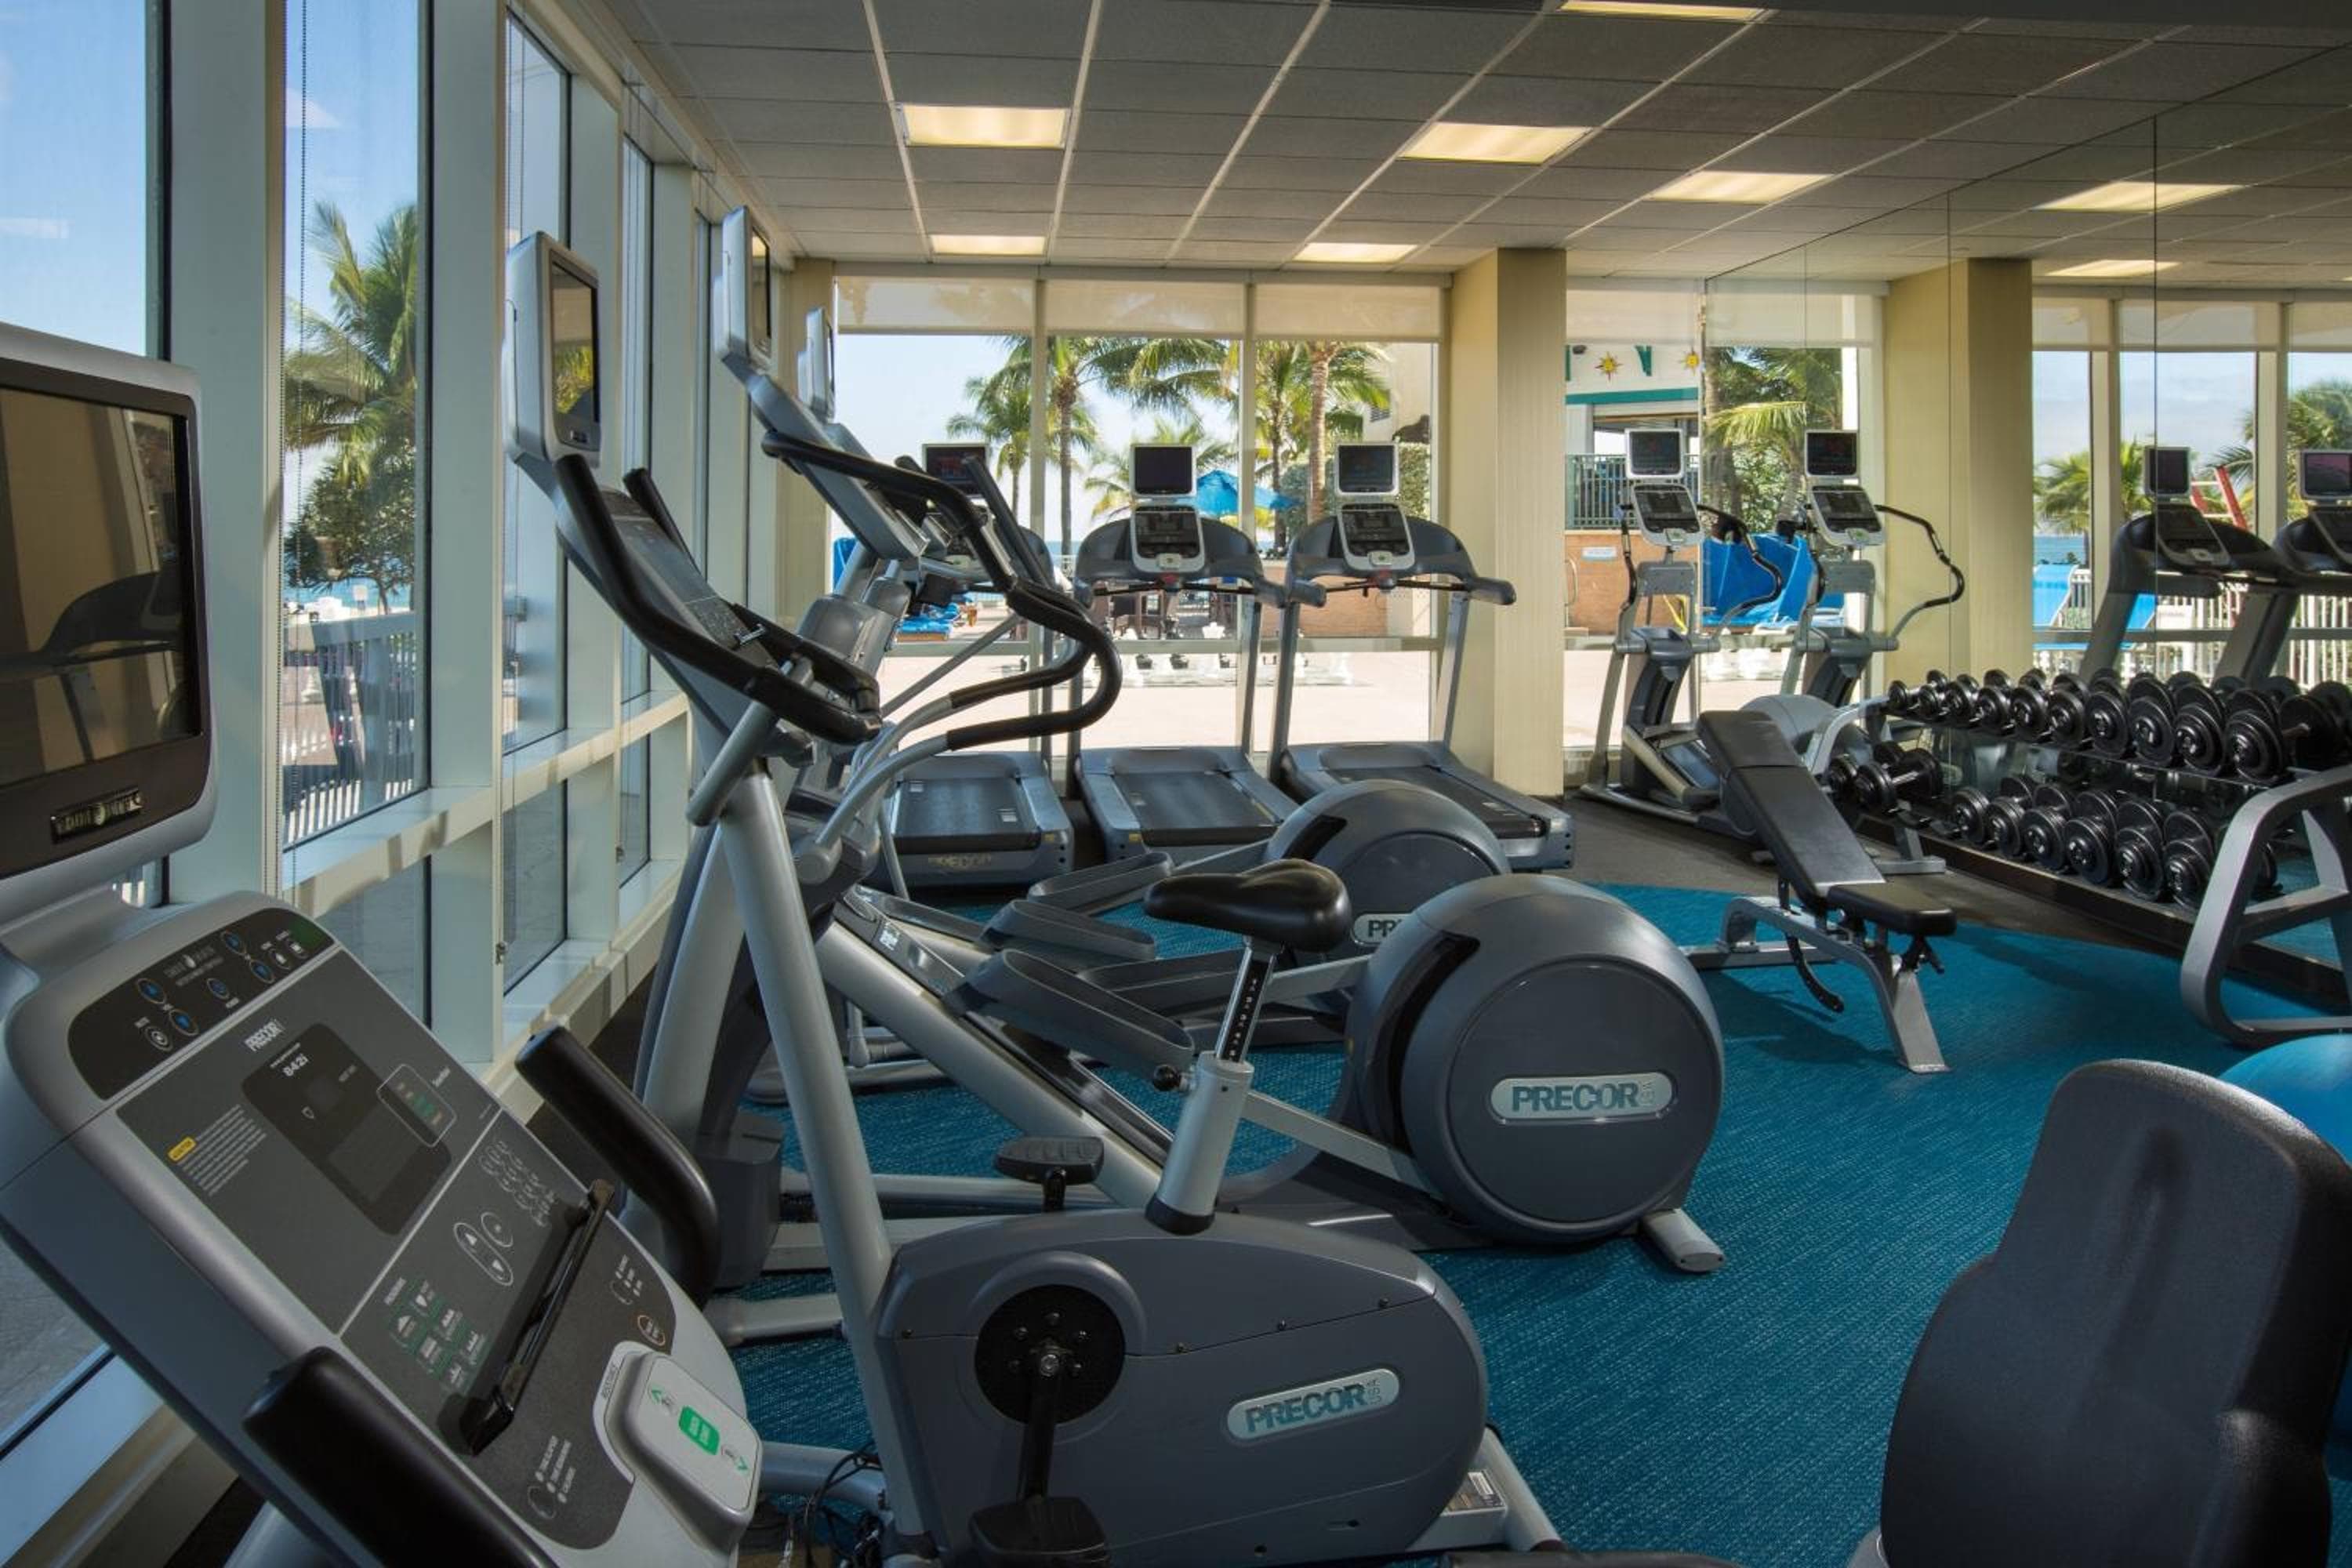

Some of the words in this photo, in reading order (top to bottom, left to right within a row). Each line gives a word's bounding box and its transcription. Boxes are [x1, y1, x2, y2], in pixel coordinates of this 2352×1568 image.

[1367, 919, 1402, 938] PR
[1512, 1083, 1639, 1112] PRECOR
[1245, 1383, 1368, 1433] PRECOR
